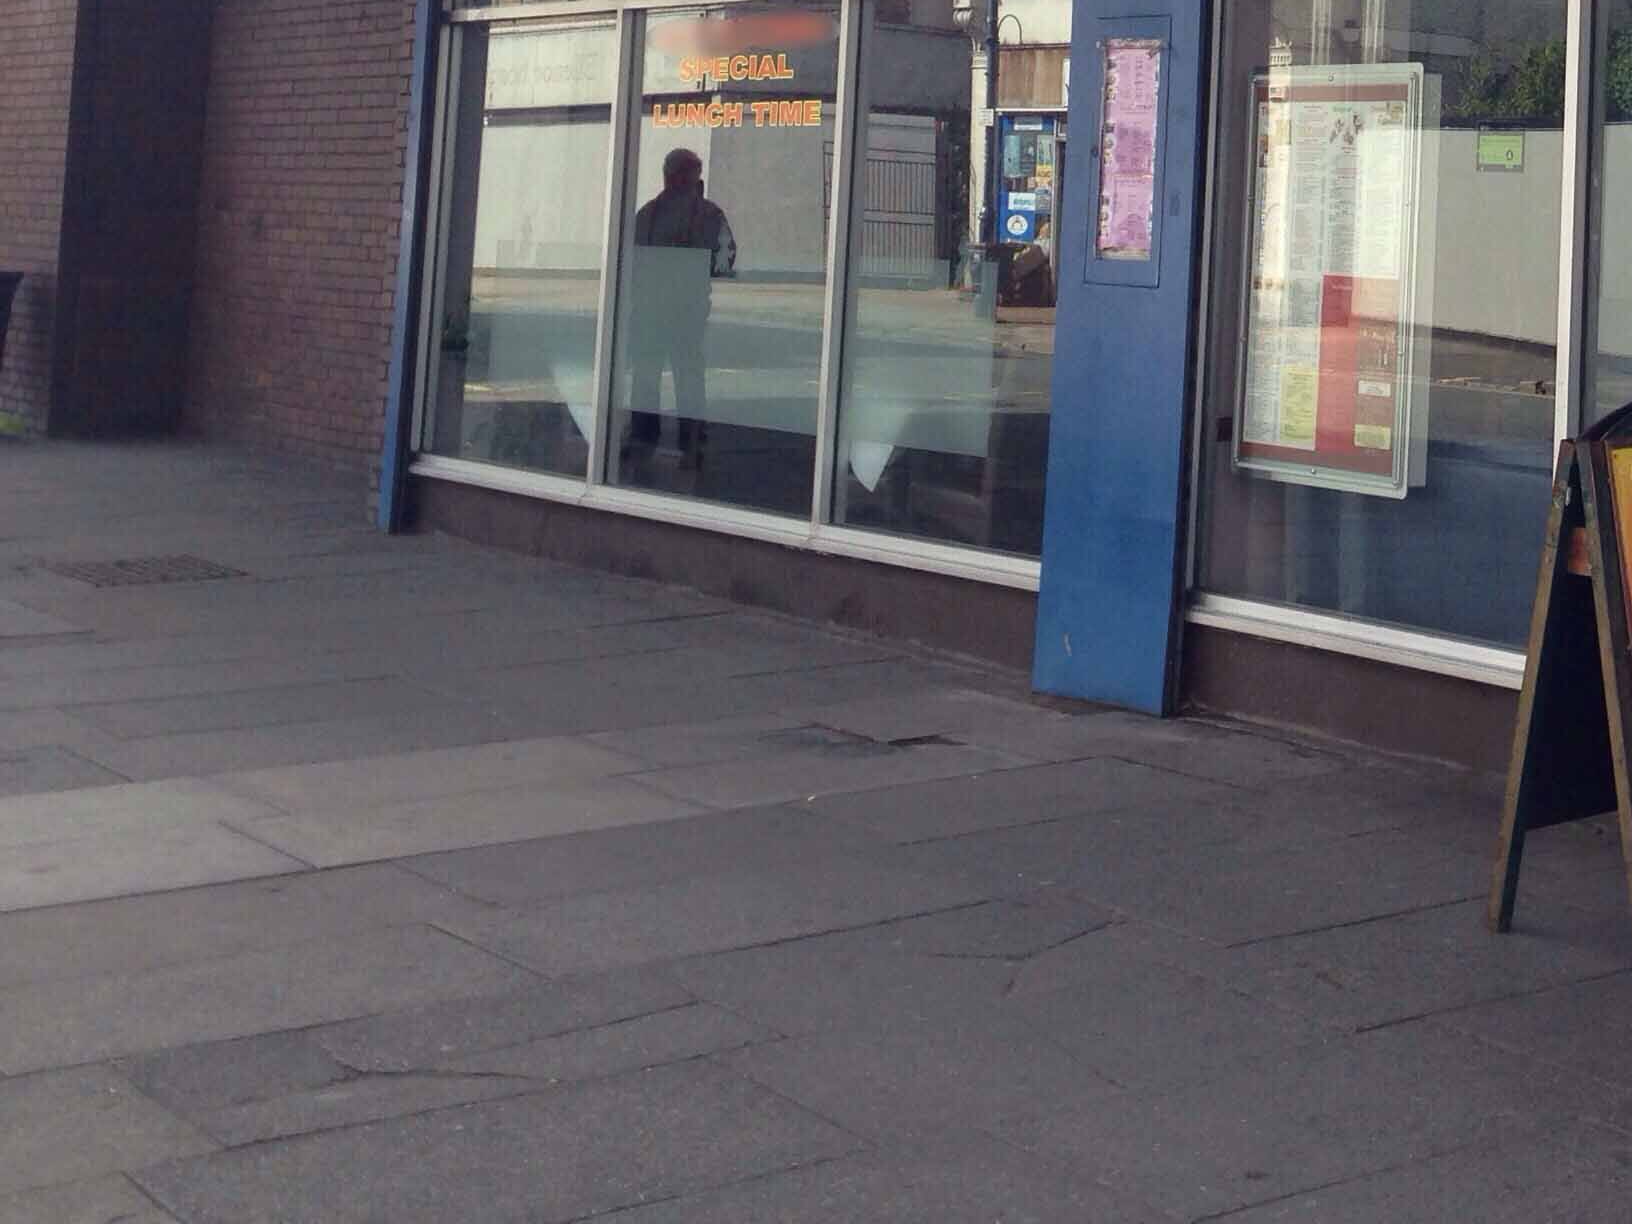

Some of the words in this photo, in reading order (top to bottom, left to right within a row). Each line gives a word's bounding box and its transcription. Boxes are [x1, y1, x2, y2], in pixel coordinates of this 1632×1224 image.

[679, 54, 794, 82] SPECIAL
[652, 102, 744, 129] LUNCH
[751, 100, 823, 127] TIME
